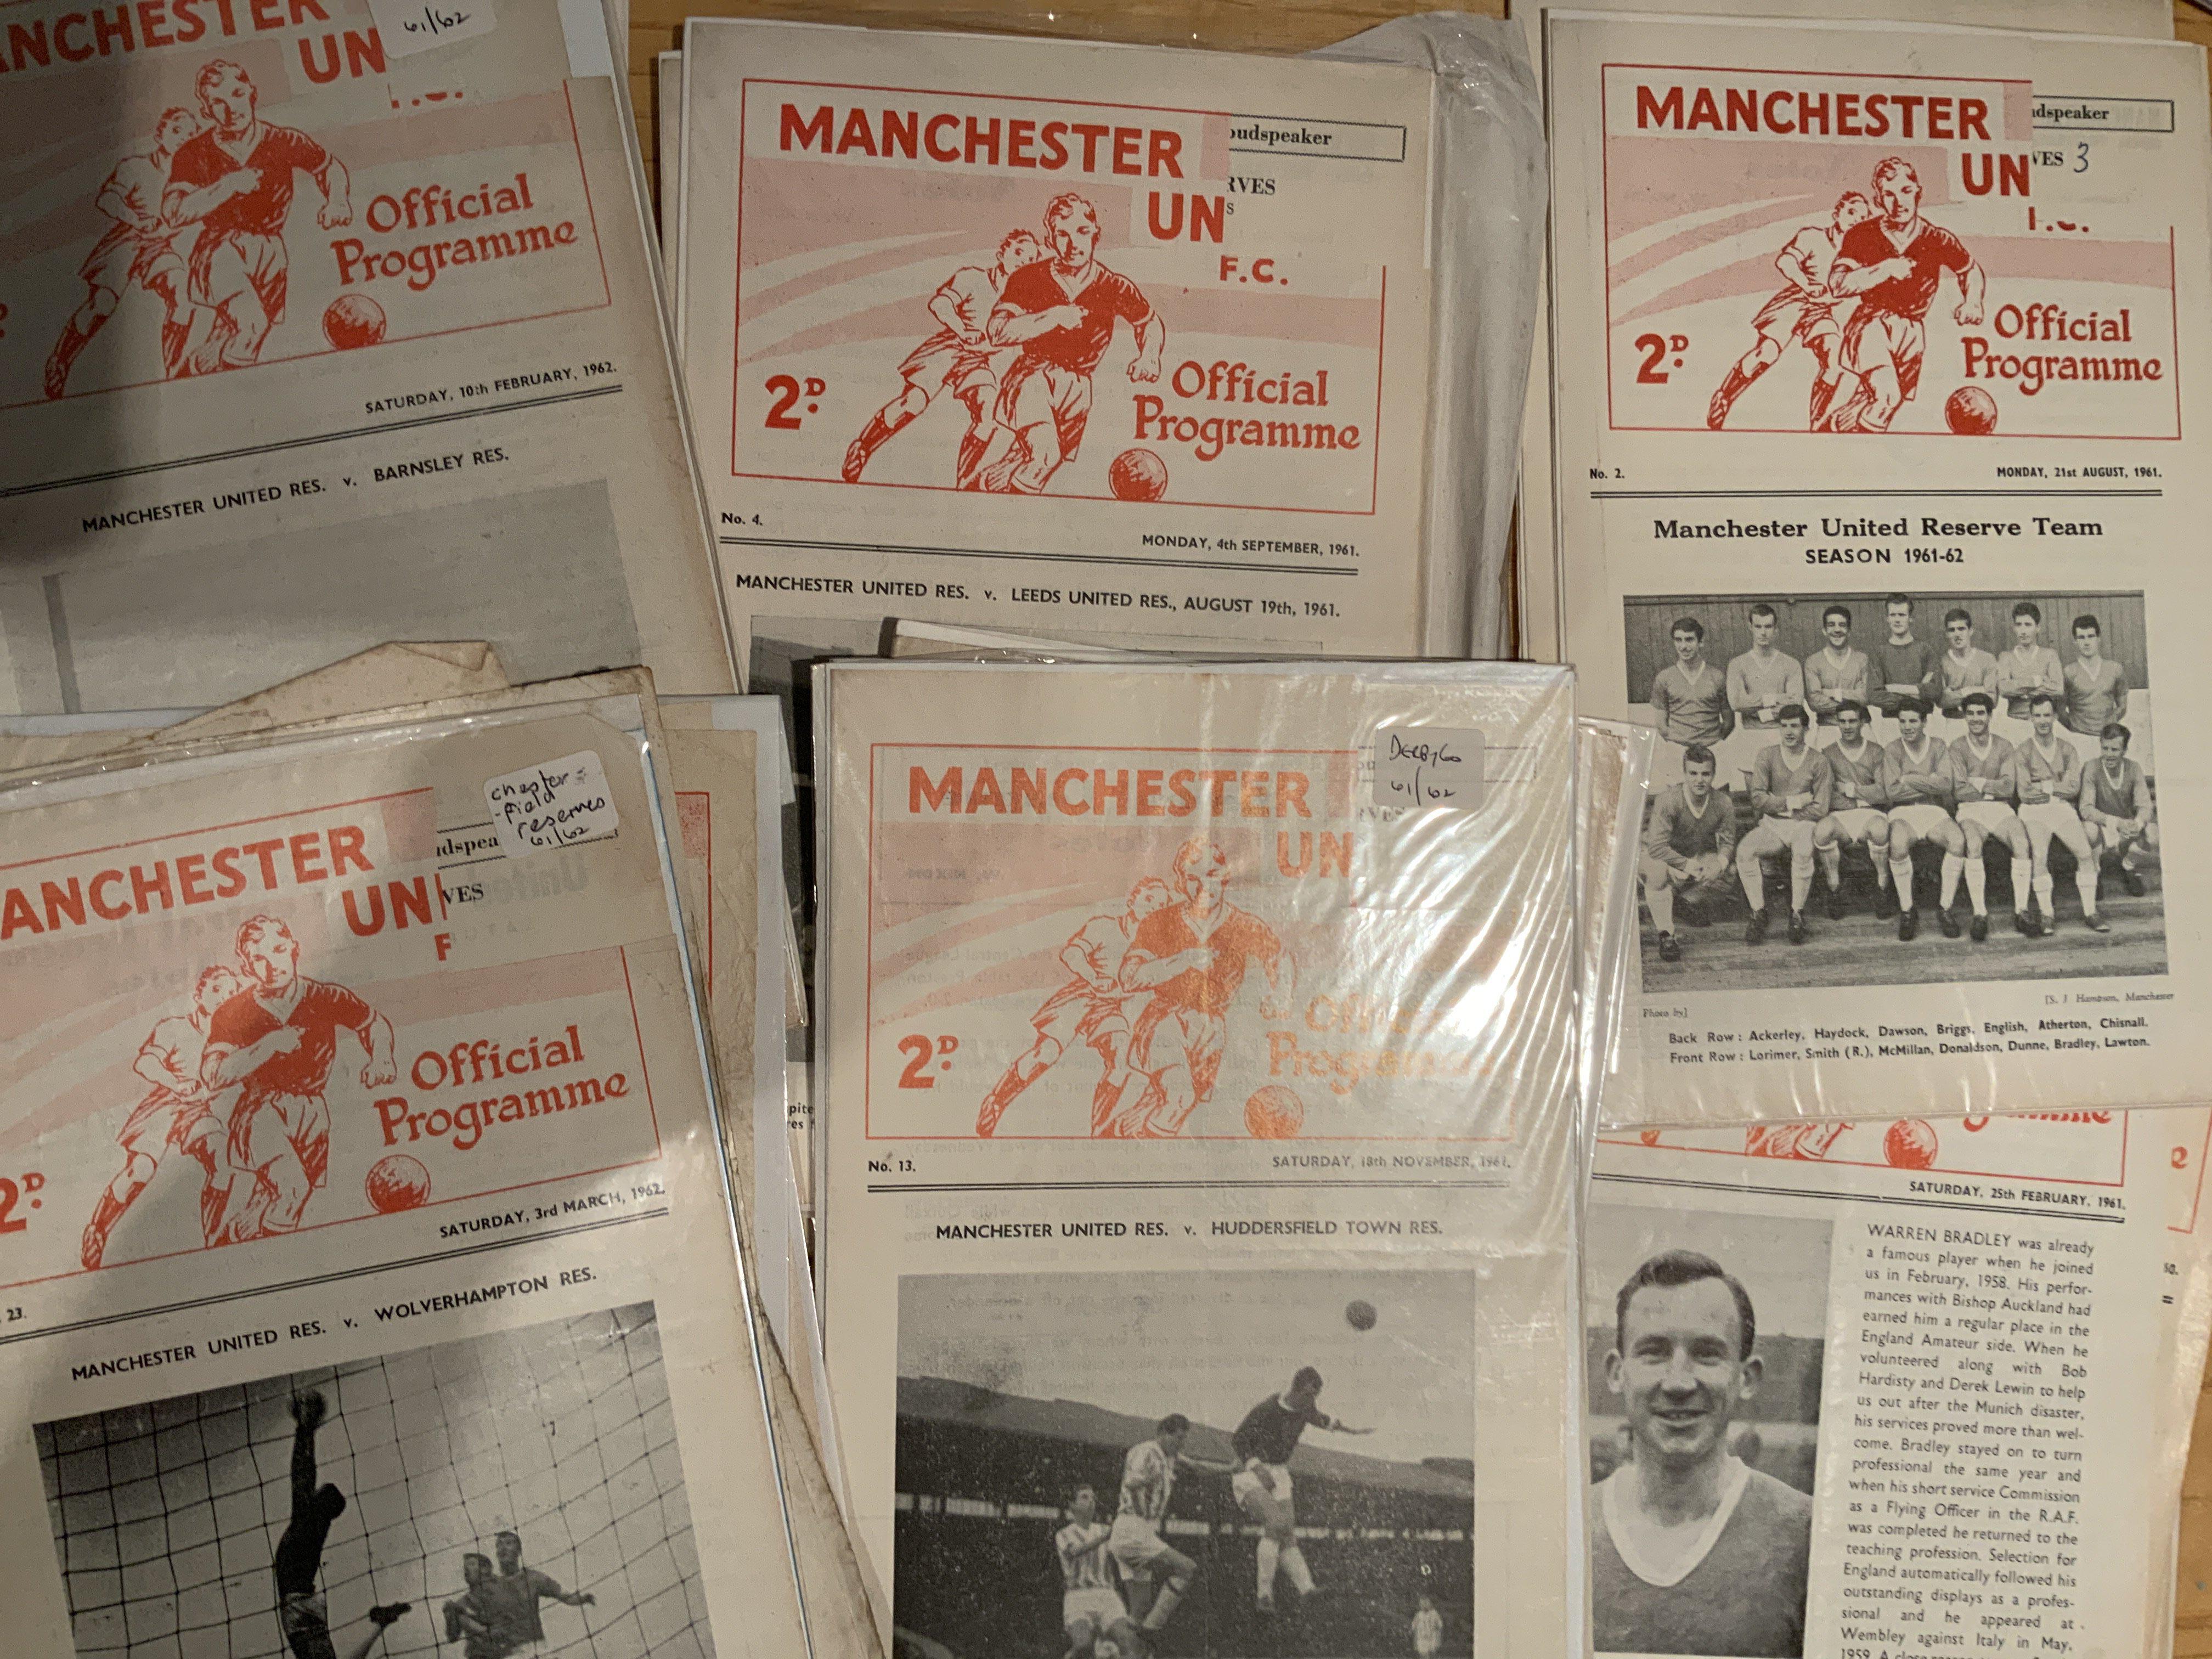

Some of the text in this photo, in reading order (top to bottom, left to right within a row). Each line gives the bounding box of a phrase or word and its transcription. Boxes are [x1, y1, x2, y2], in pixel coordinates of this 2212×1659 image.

[0, 0, 330, 74] NCHESTER
[1637, 86, 1991, 140] MANCHESTER
[780, 103, 1184, 178] MANCHESTER
[2073, 142, 2089, 173] 3
[366, 173, 533, 233] Official
[330, 217, 577, 291] Programme
[1220, 255, 1288, 285] F.C.
[1994, 303, 2131, 342] Official
[1960, 336, 2162, 397] Programme
[365, 390, 453, 414] SATURDAY,
[494, 368, 577, 392] FEBRUARY,
[583, 362, 617, 376] 1962.
[1172, 360, 1328, 407] Official
[1132, 394, 1360, 462] Programme
[1589, 468, 1625, 479] No. 2.
[1997, 466, 2162, 478] MONDAY, 21st AUGUST, 1961.
[81, 447, 509, 534] MANCHESTER UNITED RES. v. BARNSLEY RES.
[721, 512, 763, 526] No. 4.
[1654, 517, 2103, 538] Manchester United Reserve Team
[1142, 534, 1359, 556] MONDAY, 4th SEPTEMBER, 1961.
[1805, 548, 1963, 564] SEASON 1961-62
[736, 574, 1340, 617] MANCHESTER UNITED RES. v. LEEDS UNITED RES., AUGUST 19th, 1961.
[909, 766, 1311, 817] MANCHESTER
[1669, 1032, 1697, 1044] Back
[1749, 1029, 1805, 1042] Ackerley,
[1814, 1027, 1869, 1040] Haydock,
[1878, 1025, 1928, 1037] Dawson,
[1937, 1024, 1974, 1037] Briggs,
[1984, 1022, 2028, 1035] English,
[2039, 1019, 2091, 1030] Atherton,
[2100, 1017, 2148, 1029] Chisnall.
[411, 1025, 586, 1091] Official
[1670, 1052, 1703, 1063] Front
[1749, 1049, 1801, 1061] Lorimer,
[1805, 1047, 1839, 1059] Smith
[1878, 1045, 1934, 1056] McMillan,
[1939, 1042, 2003, 1054] Donaldson,
[2008, 1040, 2049, 1051] Dunne,
[2054, 1038, 2100, 1050] Bradley,
[2104, 1037, 2150, 1047] Lawton.
[373, 1072, 628, 1150] Programme
[868, 1160, 916, 1172] No. 13.
[1272, 1155, 1353, 1168] SATURDAY,
[1392, 1155, 1474, 1168] NOVEMBER,
[1910, 1181, 2125, 1209] SATURDAY, 25th FEBRUARY, 1961.
[439, 1183, 665, 1238] SATURDAY, 3rd MARCH, 1962.
[936, 1221, 1443, 1239] MANCHESTER UNITED RES. v. HUDDERSFIELD TOWN RES.
[1867, 1224, 2094, 1257] WARREN BRADLEY was already
[1866, 1245, 2094, 1275] a famous player when he joined
[1865, 1268, 2092, 1296] us in February, 1958. His perfor-
[1864, 1291, 2091, 1316] mances with Bishop Auckland had
[71, 1267, 596, 1381] MANCHESTER UNITED RES. v. WOLVERHAMPTON RES.
[1859, 1372, 2086, 1402] Hardisty and Derek Lewin to help
[1846, 1543, 2076, 1566] teaching profession. Selection for
[1843, 1562, 2076, 1587] England automatically followed his
